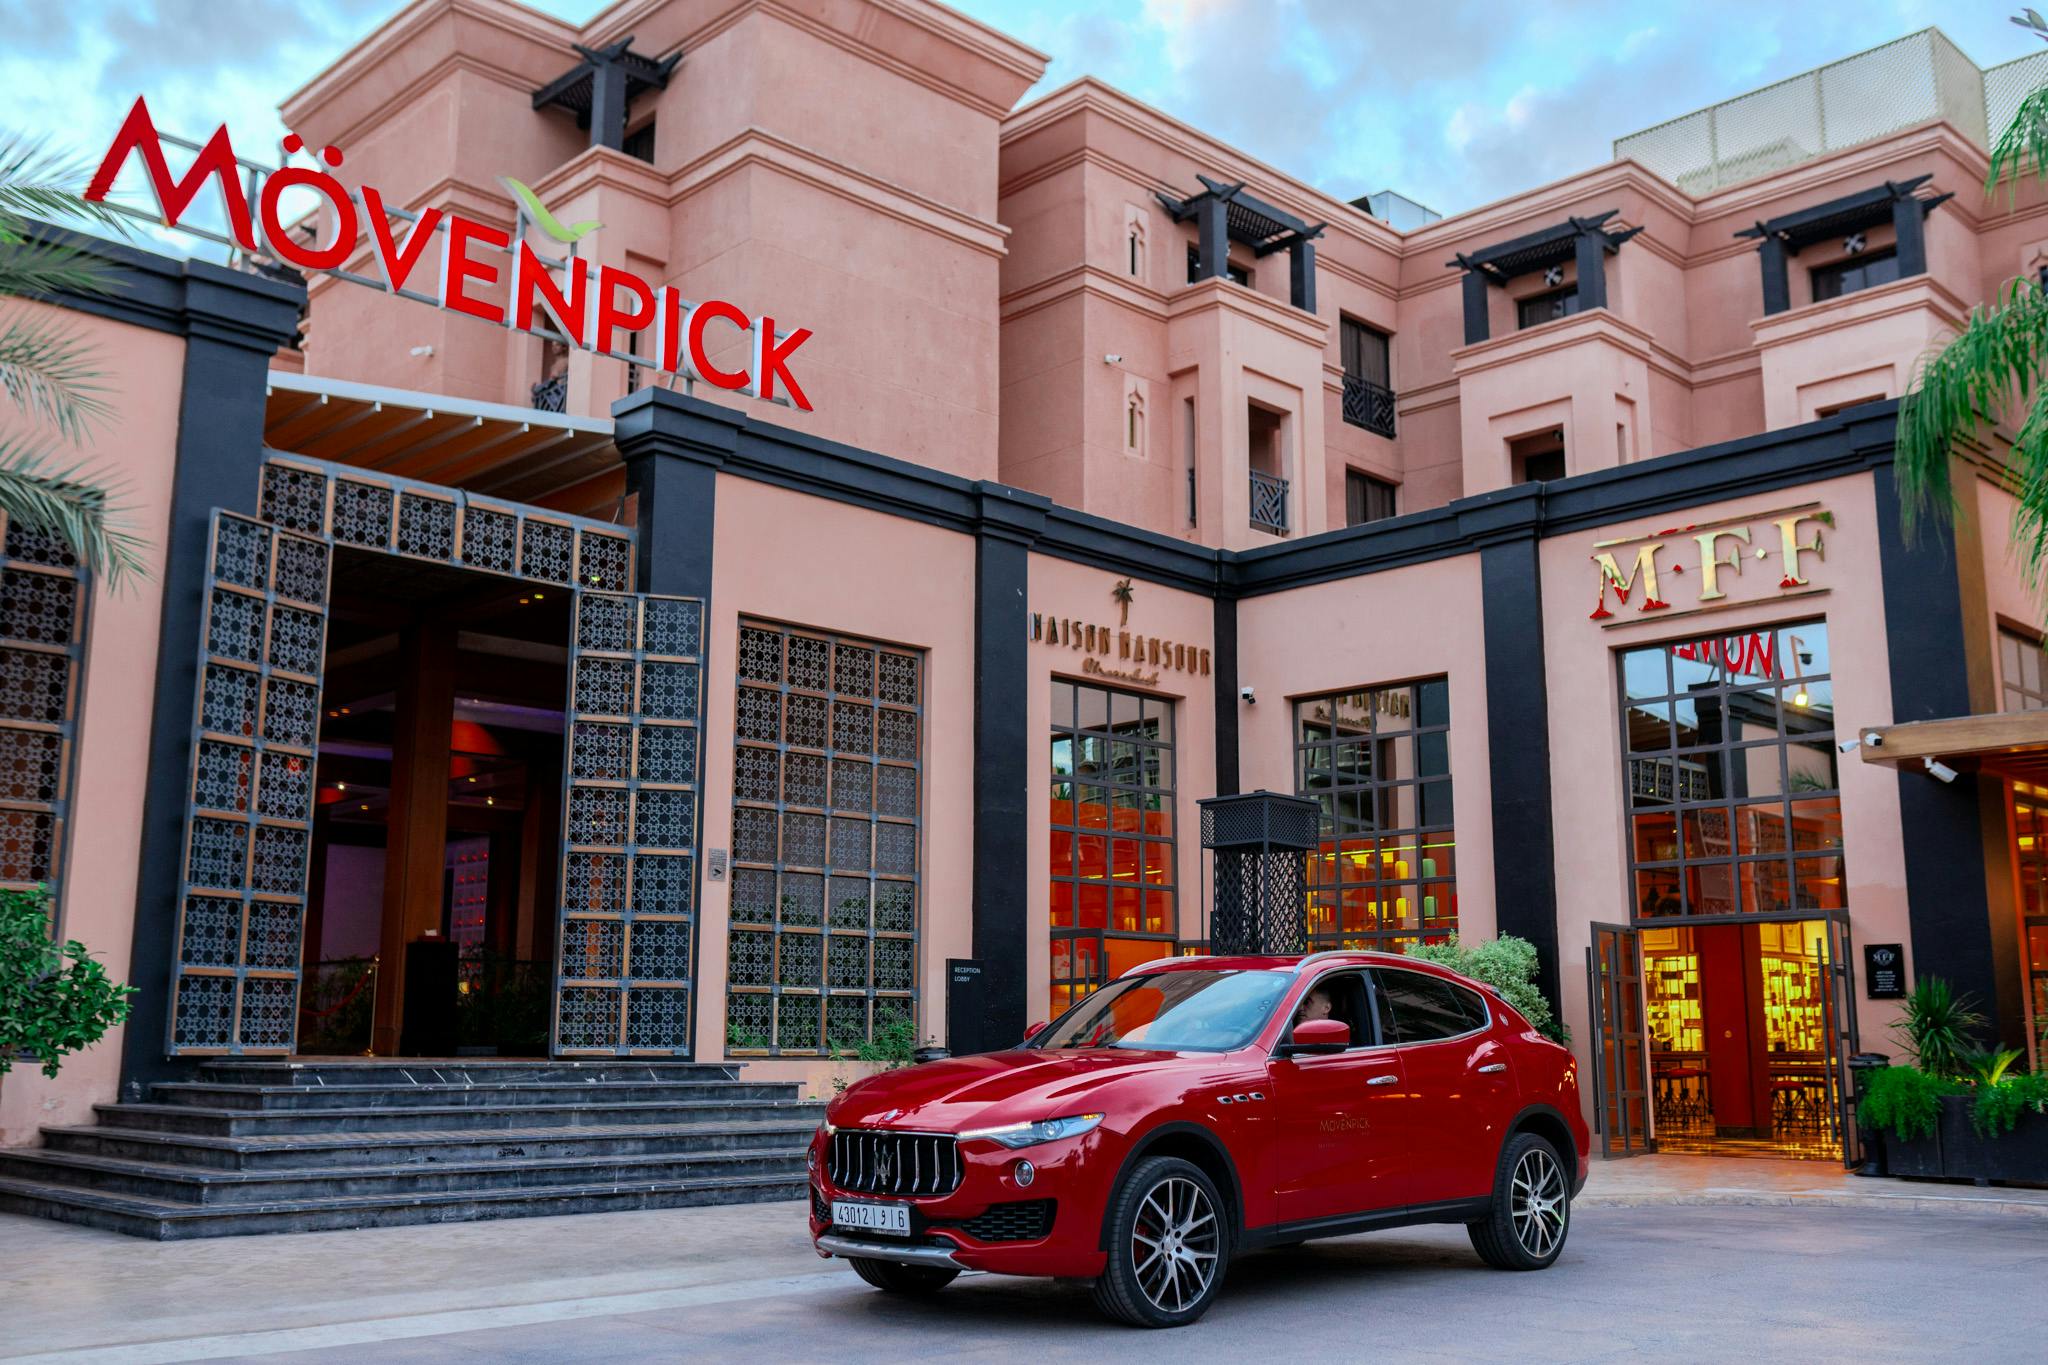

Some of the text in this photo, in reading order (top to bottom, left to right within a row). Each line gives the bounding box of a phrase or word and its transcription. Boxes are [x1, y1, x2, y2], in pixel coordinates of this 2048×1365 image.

[84, 95, 814, 412] MÖVENPICK
[1029, 613, 1210, 676] MAISON MANSOUR
[838, 1206, 868, 1225] 43012
[898, 1210, 904, 1228] 6
